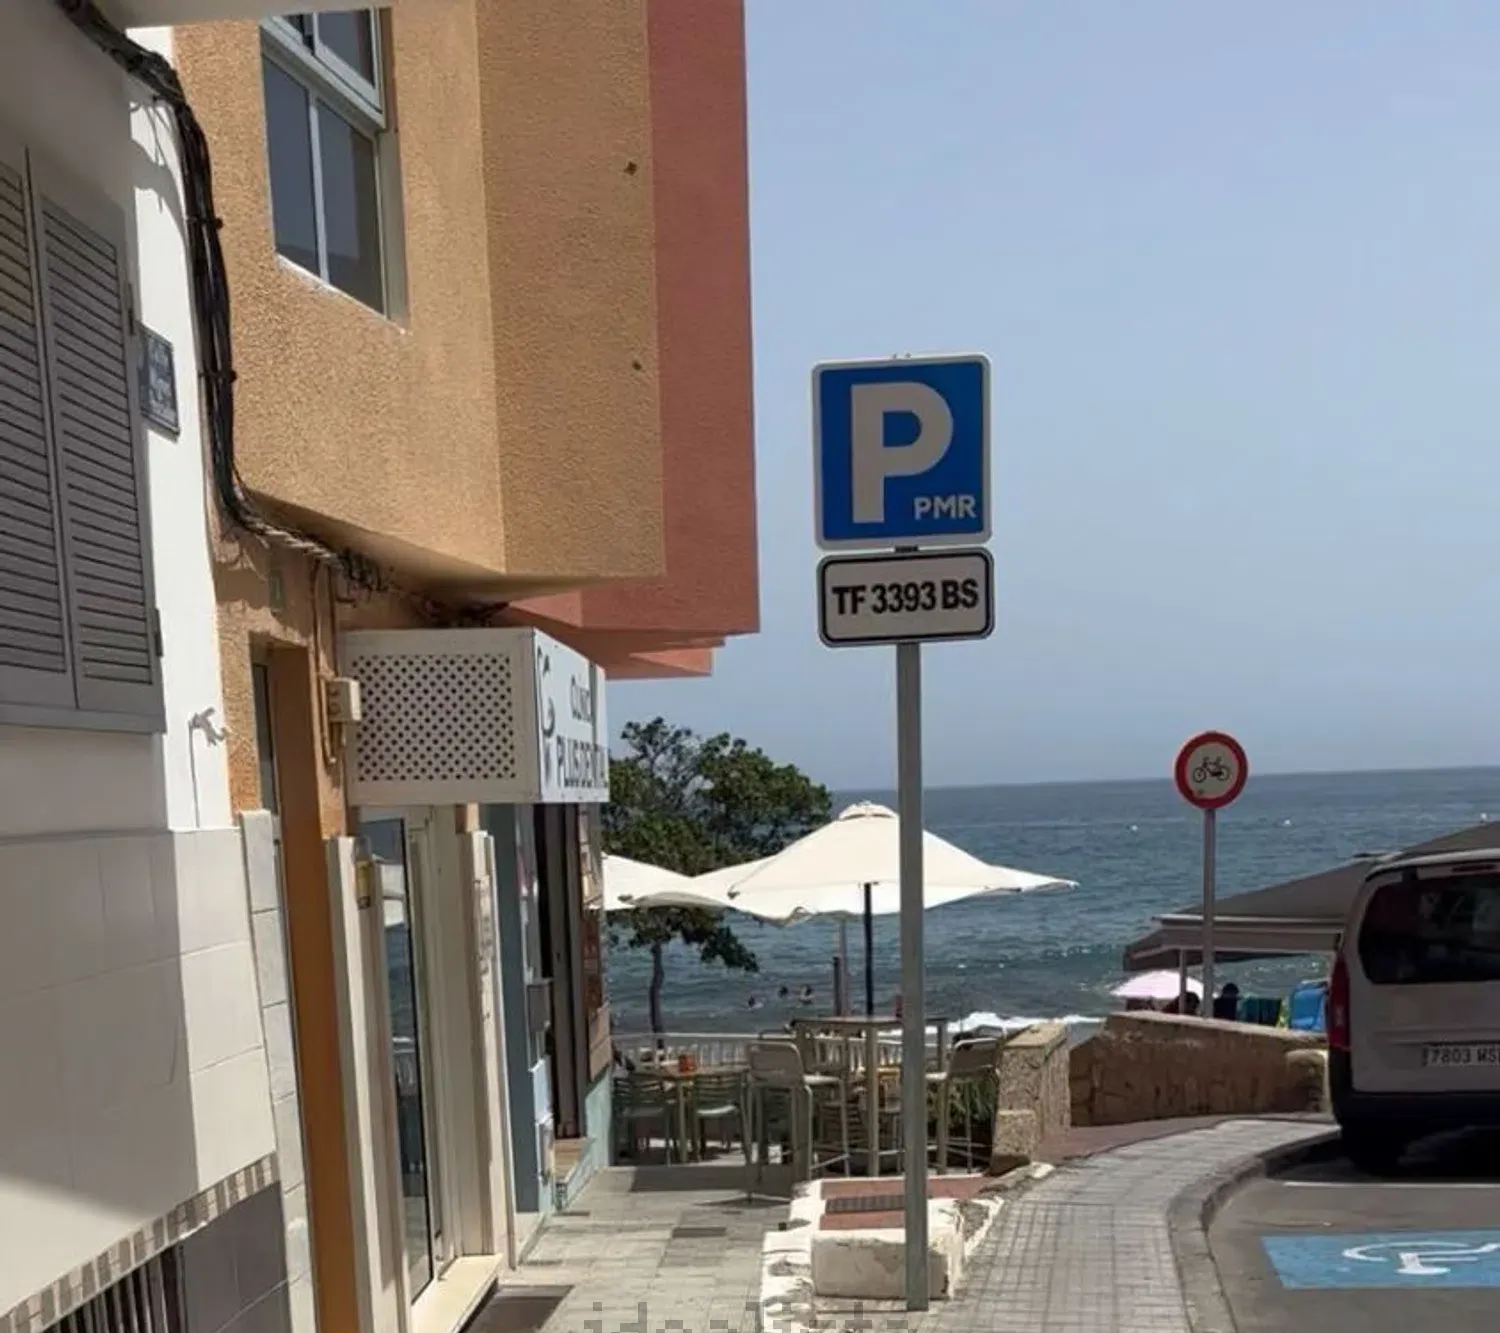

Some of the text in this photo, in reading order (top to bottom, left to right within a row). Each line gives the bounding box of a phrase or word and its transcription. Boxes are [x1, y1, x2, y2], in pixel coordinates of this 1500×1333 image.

[851, 381, 954, 524] P
[913, 494, 977, 521] PMR
[831, 577, 979, 616] TF 3393 BS
[1429, 1047, 1472, 1064] 7803
